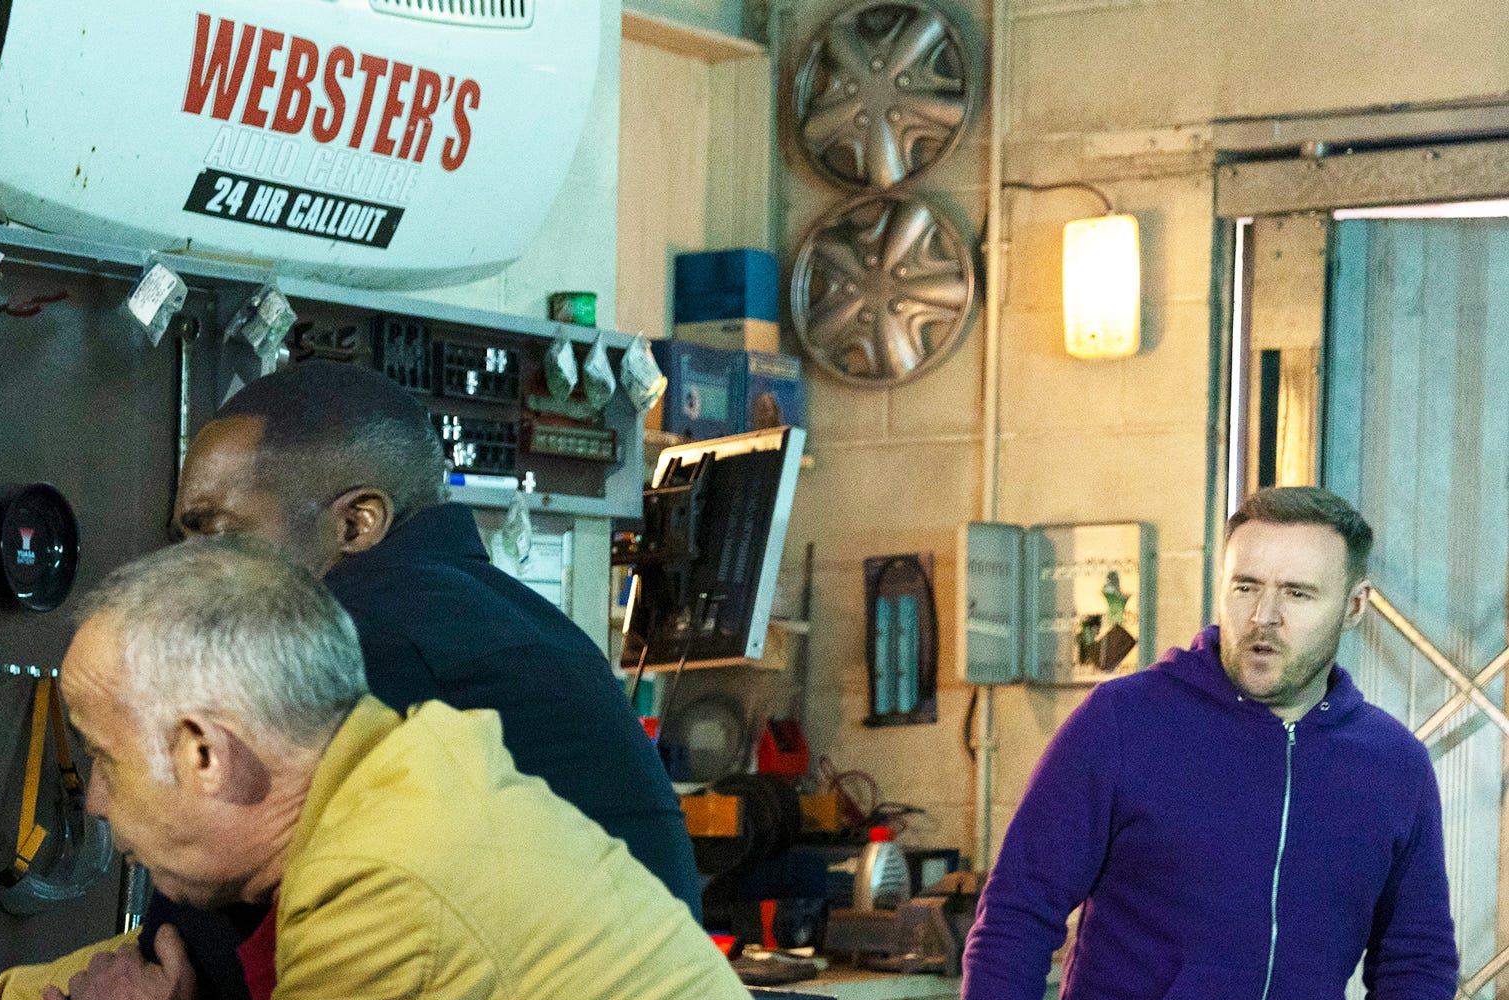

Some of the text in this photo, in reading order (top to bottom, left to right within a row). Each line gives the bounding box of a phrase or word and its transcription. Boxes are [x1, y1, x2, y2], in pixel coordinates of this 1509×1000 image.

[180, 12, 481, 172] WEBSTER'S
[203, 124, 422, 205] AUTO CENTRE
[205, 176, 388, 242] 24 HR CALLOUT
